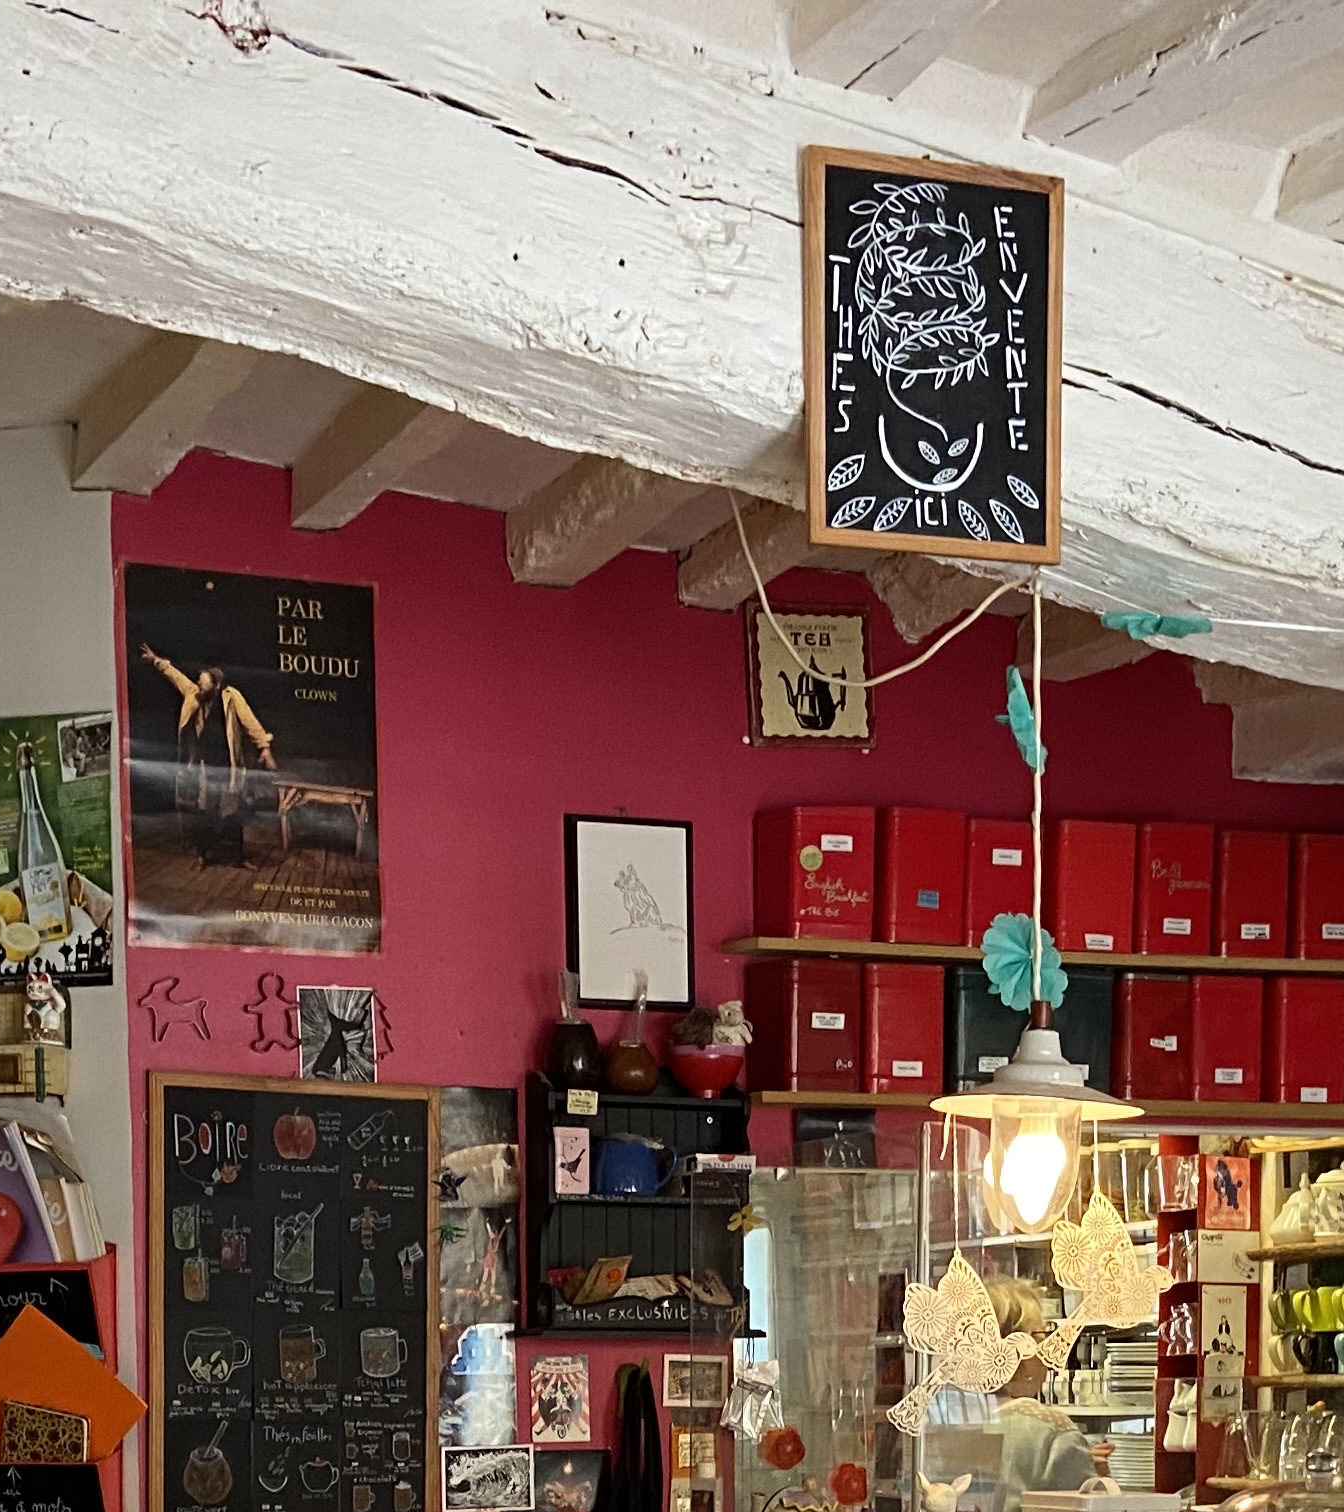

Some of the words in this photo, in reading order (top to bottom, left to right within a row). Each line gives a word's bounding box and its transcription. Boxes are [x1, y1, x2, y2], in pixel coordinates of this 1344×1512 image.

[278, 596, 324, 621] PAR
[278, 625, 308, 647] LE
[279, 653, 360, 679] BOUDU
[294, 687, 338, 702] CLOWN
[235, 910, 328, 926] BONAVENTURE
